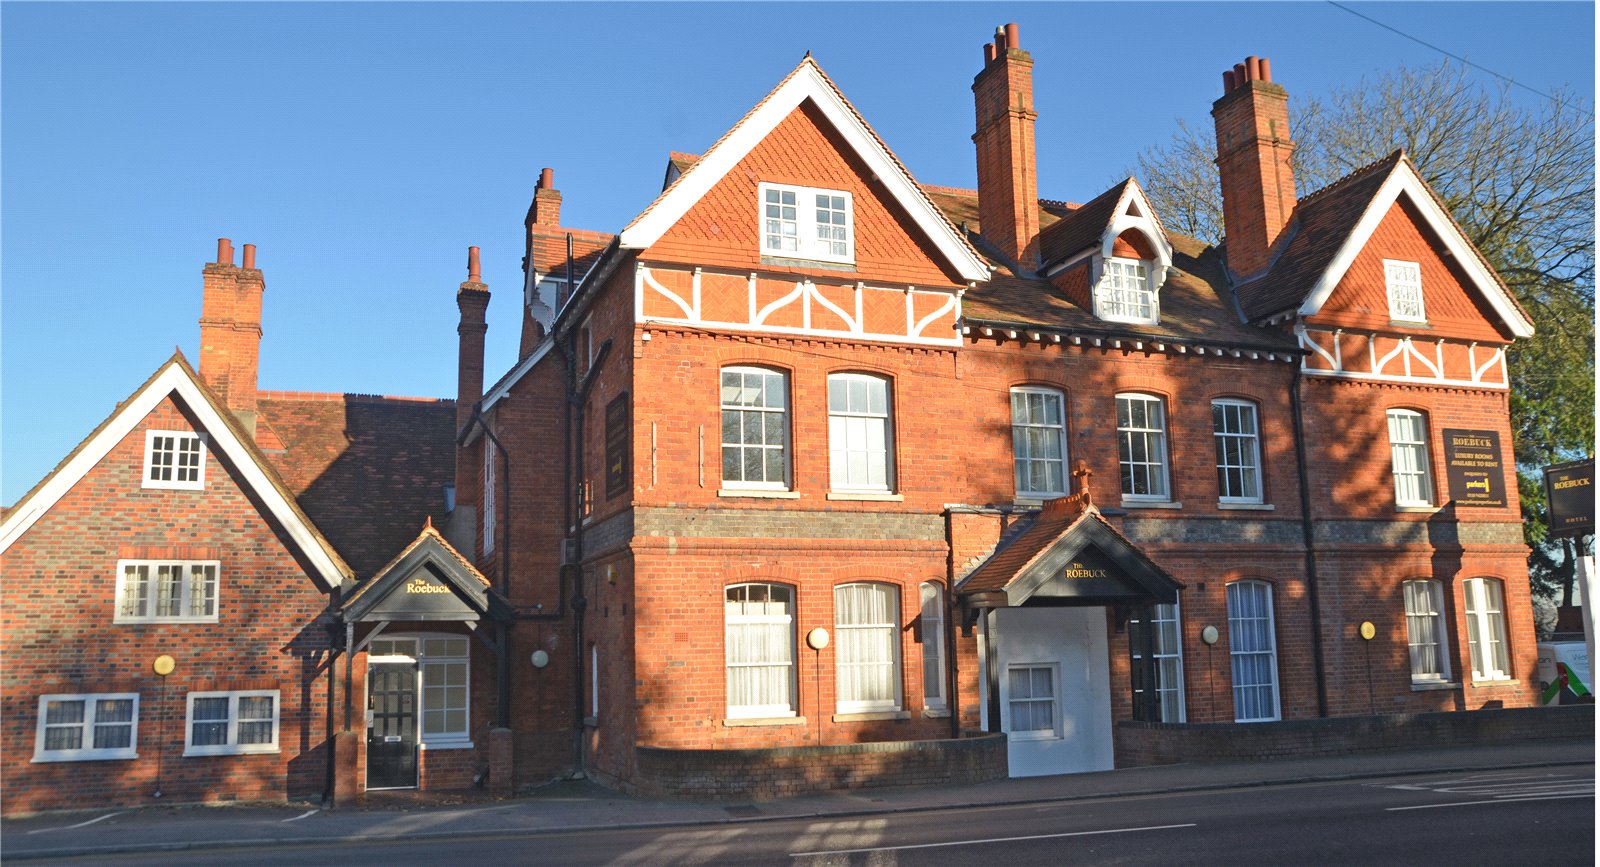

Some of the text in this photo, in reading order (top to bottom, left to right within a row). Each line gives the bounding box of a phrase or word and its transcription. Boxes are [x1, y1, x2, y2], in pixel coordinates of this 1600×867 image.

[1453, 438, 1492, 447] ROEBUCK
[1554, 478, 1590, 490] ROEBUCK
[1066, 569, 1106, 578] ROEBUCK
[407, 583, 451, 593] Roebuck
